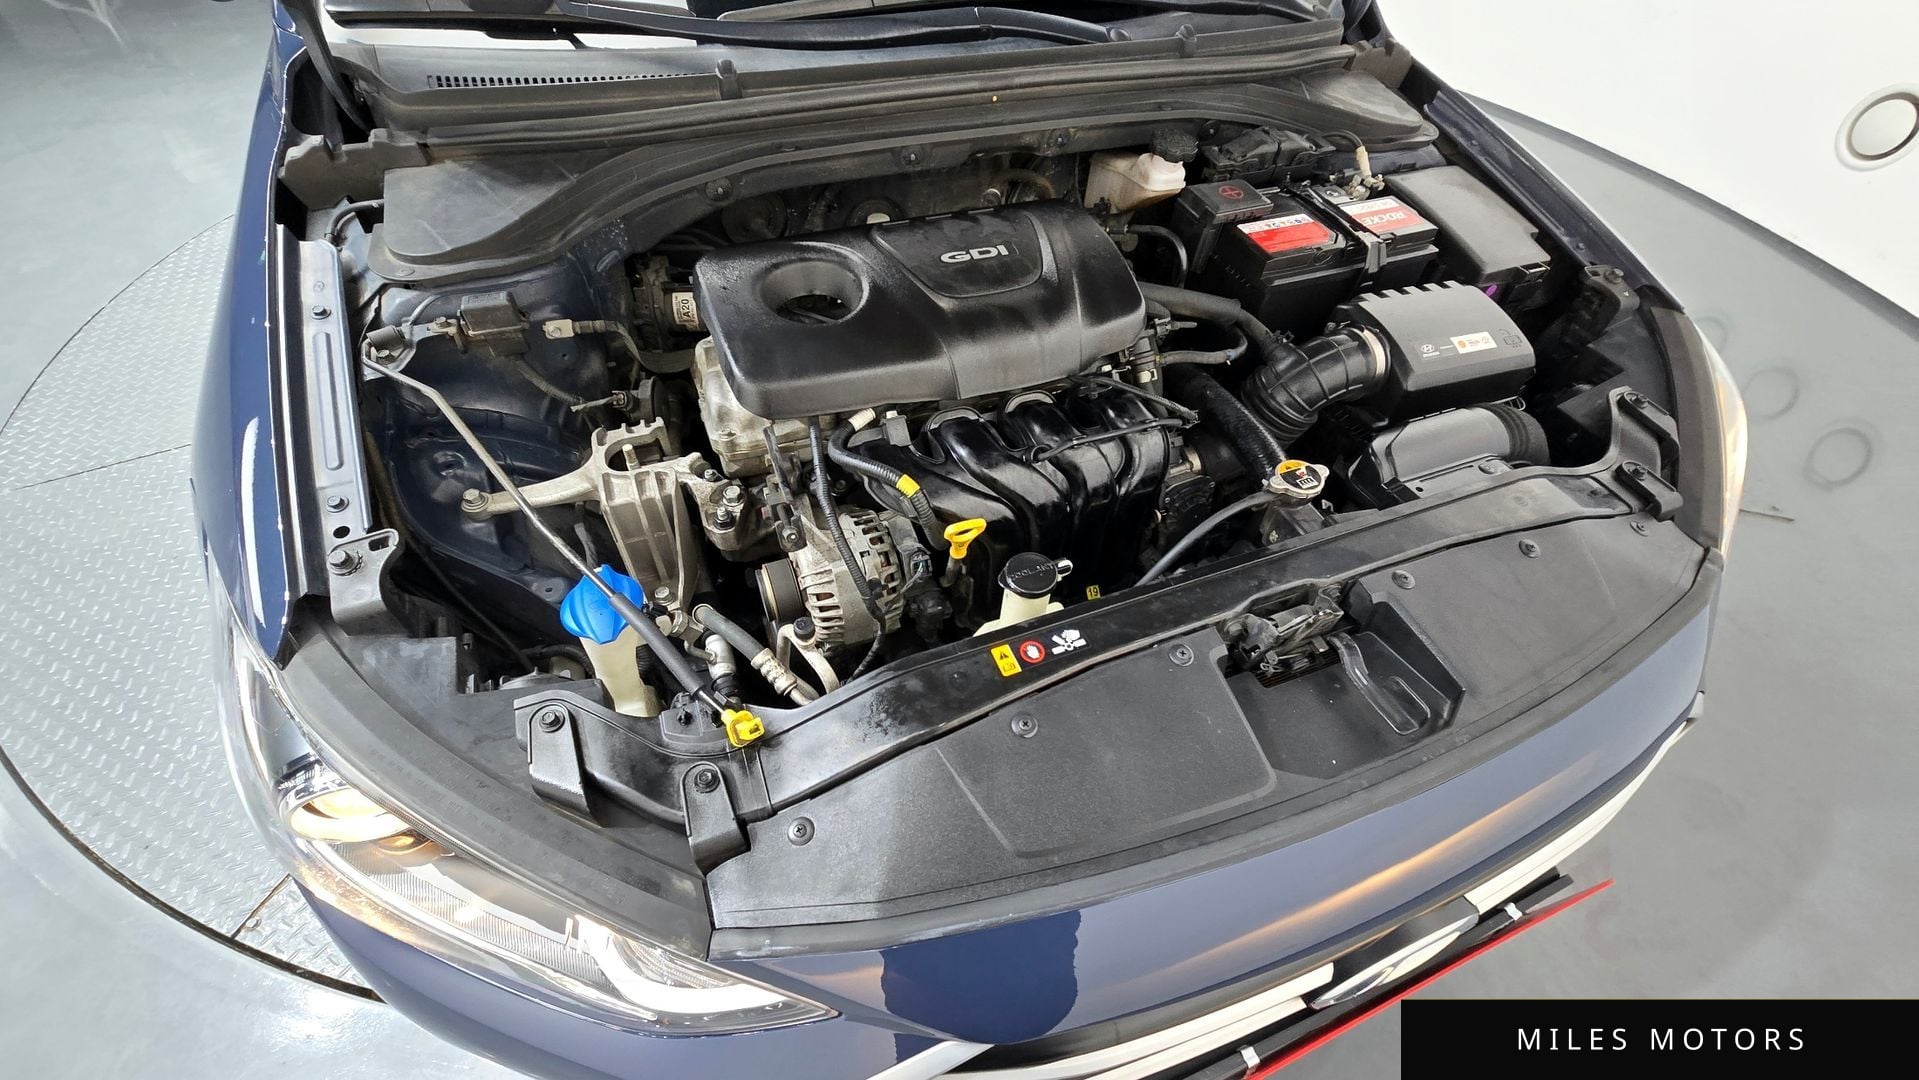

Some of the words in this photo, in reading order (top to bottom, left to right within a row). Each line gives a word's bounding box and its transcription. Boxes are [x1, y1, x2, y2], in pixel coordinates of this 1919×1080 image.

[1362, 211, 1406, 226] ROCKE
[940, 245, 1009, 263] GDI
[680, 298, 691, 318] A20
[1007, 562, 1054, 581] COOLANT
[1087, 587, 1099, 598] 19
